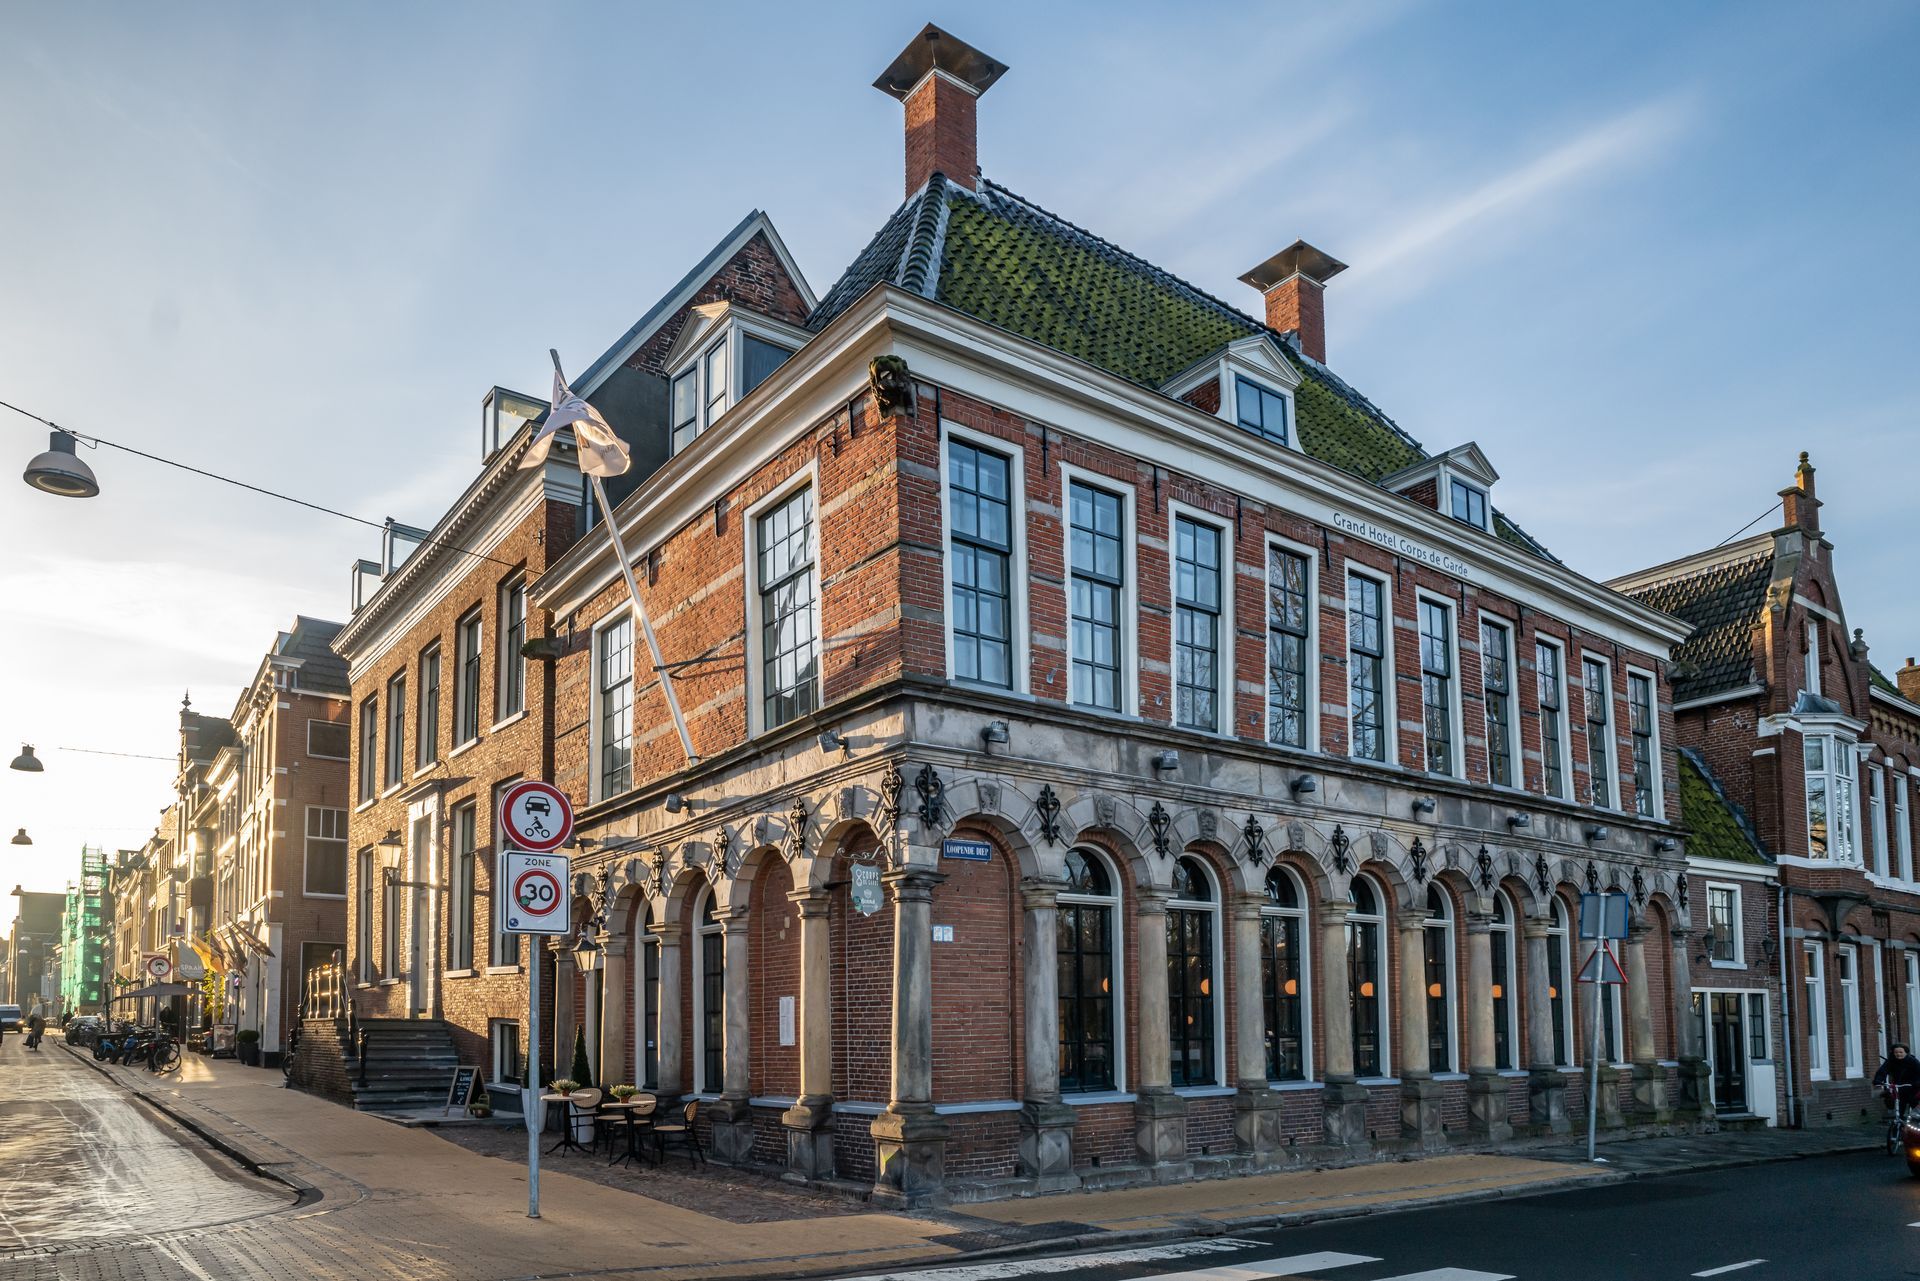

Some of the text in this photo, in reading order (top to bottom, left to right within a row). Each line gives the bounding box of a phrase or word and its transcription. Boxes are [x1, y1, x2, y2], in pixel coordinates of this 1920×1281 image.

[1333, 512, 1468, 577] Grand Hotel Corps de Garde
[946, 844, 989, 856] LOOPENDE DIEP
[525, 858, 551, 867] ZONE
[862, 870, 879, 880] CORPS
[525, 884, 553, 901] 30
